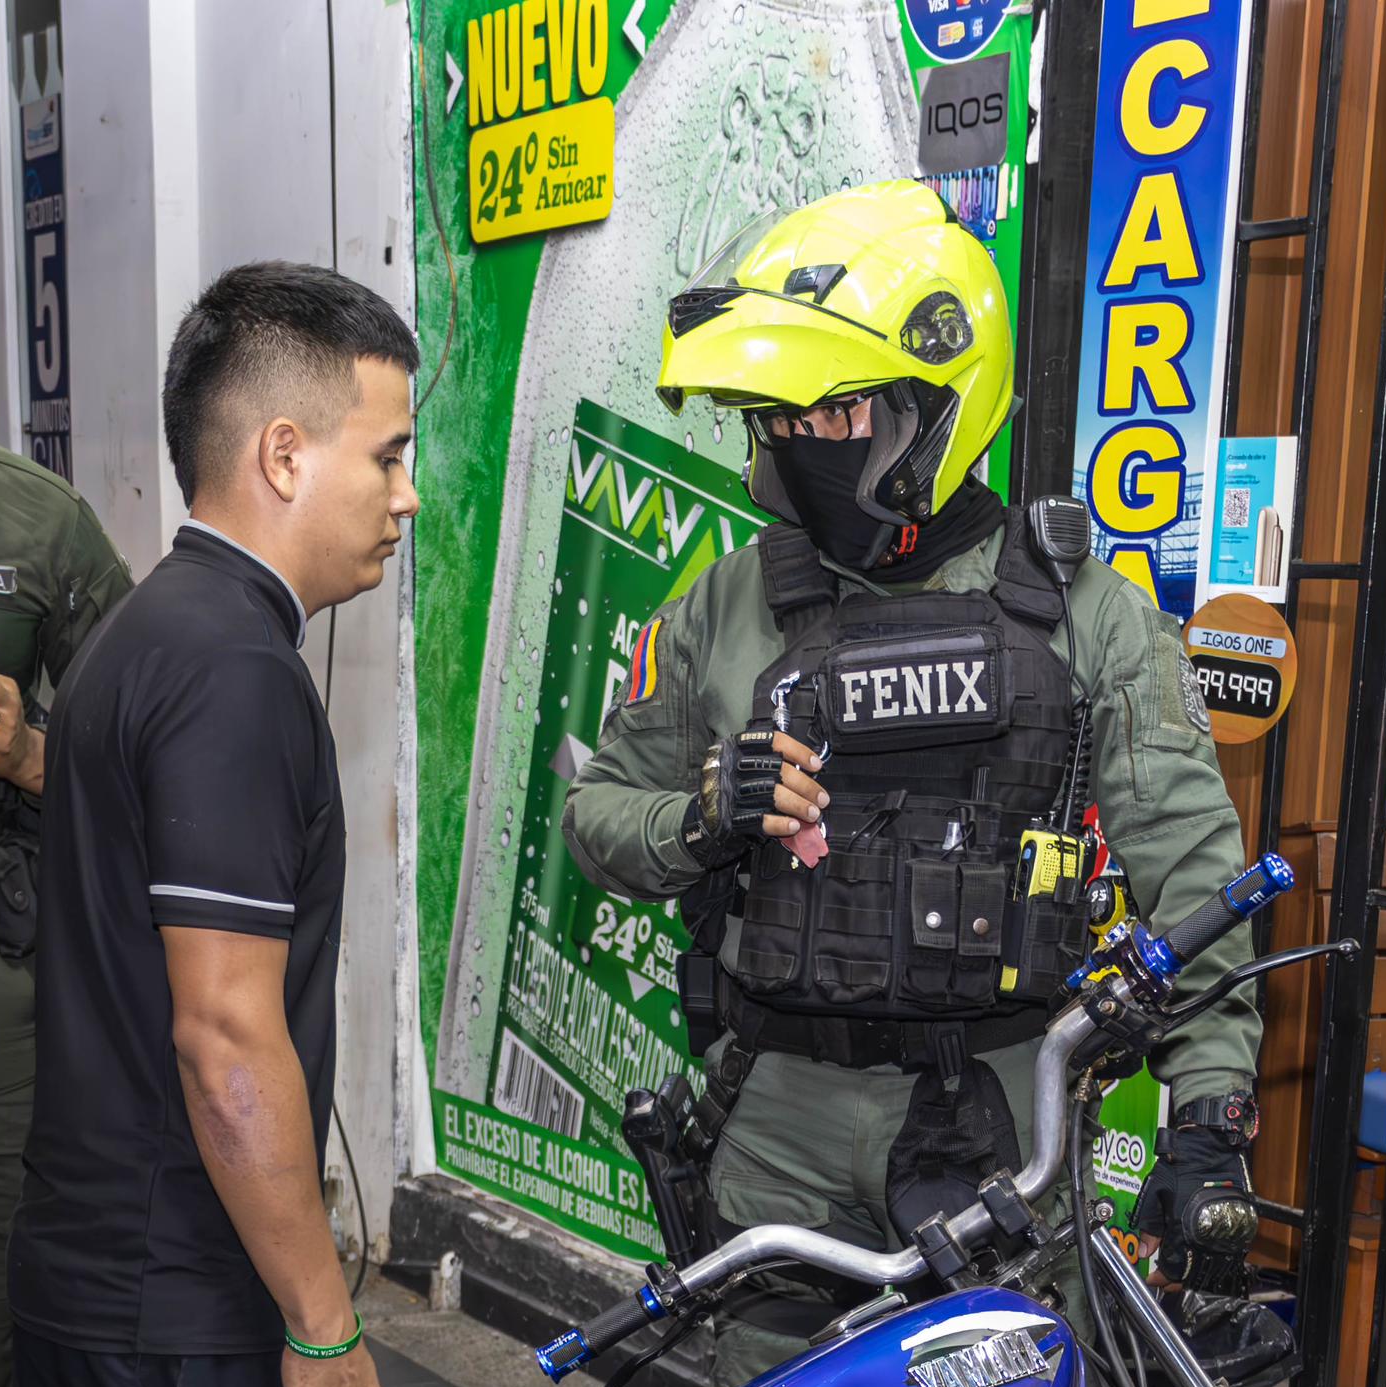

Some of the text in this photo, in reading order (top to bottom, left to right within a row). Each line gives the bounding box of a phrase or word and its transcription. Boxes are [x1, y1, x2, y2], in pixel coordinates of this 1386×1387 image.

[928, 0, 950, 13] VISA
[467, 0, 609, 127] NUEVO
[928, 93, 1003, 136] IQOS
[547, 135, 579, 170] Sin
[535, 170, 607, 211] Azúcar
[33, 231, 61, 393] 5
[30, 398, 69, 433] MINUTOS
[1200, 631, 1273, 656] IQOS ONE
[840, 661, 988, 723] FENIX
[519, 887, 550, 928] 375ml
[445, 1104, 463, 1140] EL
[465, 1110, 520, 1163] EXCESO
[523, 1131, 543, 1171] DE
[545, 1141, 615, 1201] ALCOHOL
[617, 1168, 639, 1213] ES
[445, 1143, 499, 1183] PROHÍBASE
[499, 1163, 511, 1189] EL
[513, 1167, 560, 1209] EXPENDIO
[562, 1189, 574, 1217] DE
[575, 1195, 622, 1236] BEBIDAS
[623, 1212, 667, 1255] EMBRIA
